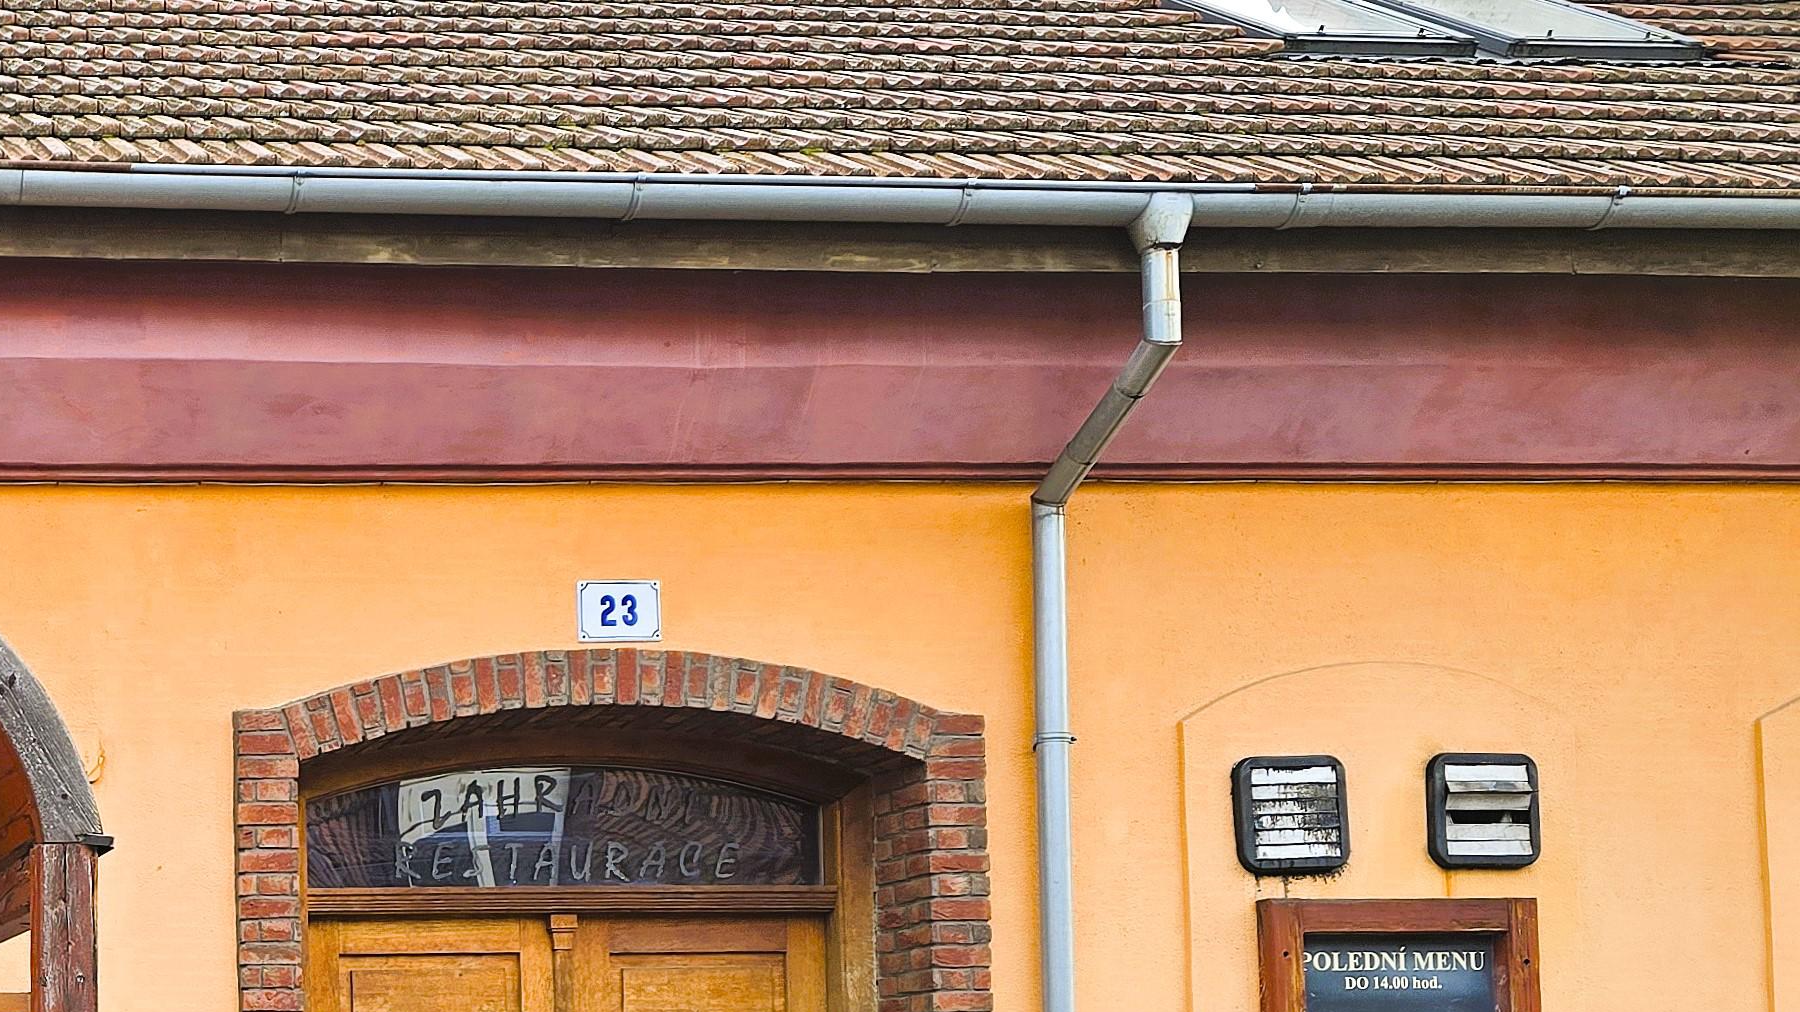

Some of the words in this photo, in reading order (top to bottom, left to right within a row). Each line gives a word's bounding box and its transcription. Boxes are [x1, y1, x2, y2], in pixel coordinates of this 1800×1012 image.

[599, 593, 639, 627] 23
[394, 839, 741, 882] RESTAURACE
[1413, 950, 1486, 972] MENU
[1344, 976, 1370, 990] DO
[1373, 976, 1409, 990] 14.00
[1412, 975, 1443, 990] hod.
